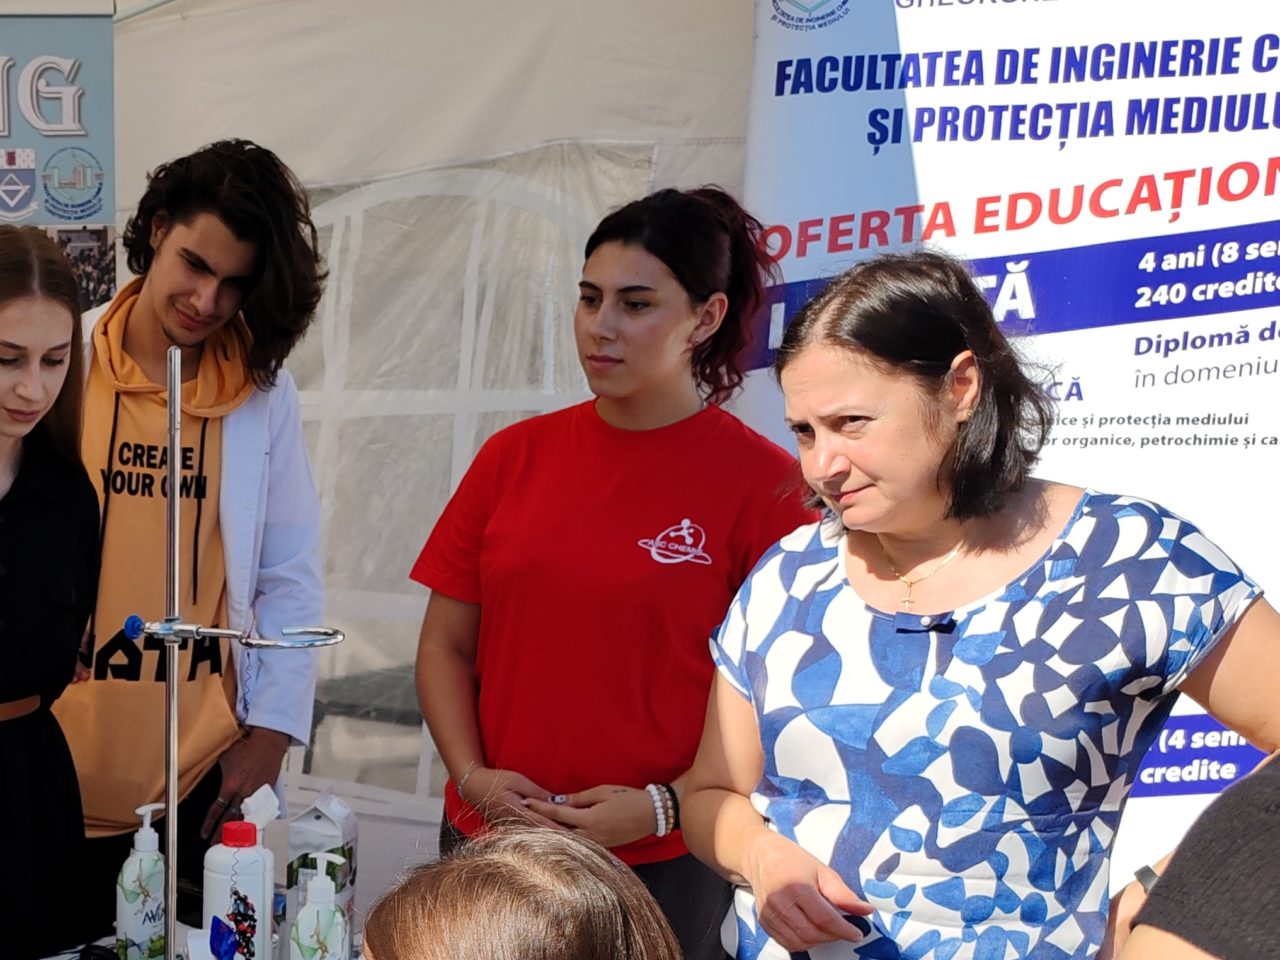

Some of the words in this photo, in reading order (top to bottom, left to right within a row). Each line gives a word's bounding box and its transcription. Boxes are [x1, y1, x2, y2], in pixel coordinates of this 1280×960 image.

[774, 50, 983, 96] FACULTATEA
[995, 48, 1038, 85] DE
[1048, 37, 1241, 83] INGINERIE
[867, 107, 903, 155] ȘI
[913, 101, 1115, 151] PROTECȚIA
[758, 202, 956, 264] OFERTA
[1138, 252, 1156, 273] 4
[1161, 244, 1205, 270] ani
[1211, 242, 1239, 268] (8
[1245, 240, 1280, 260] se
[1134, 282, 1186, 308] 240
[1134, 324, 1250, 358] Diplomă
[1258, 320, 1280, 342] d
[1135, 369, 1155, 388] în
[1164, 356, 1278, 385] domeniu
[1082, 413, 1094, 428] și
[1098, 413, 1171, 429] protecția
[1176, 413, 1250, 425] mediului
[1062, 434, 1136, 449] organice,
[1140, 433, 1239, 449] petrochimie
[1243, 434, 1256, 449] și
[118, 442, 194, 471] CREAE
[100, 469, 155, 498] YOUR
[1159, 729, 1185, 753] (4
[1140, 758, 1237, 784] credite
